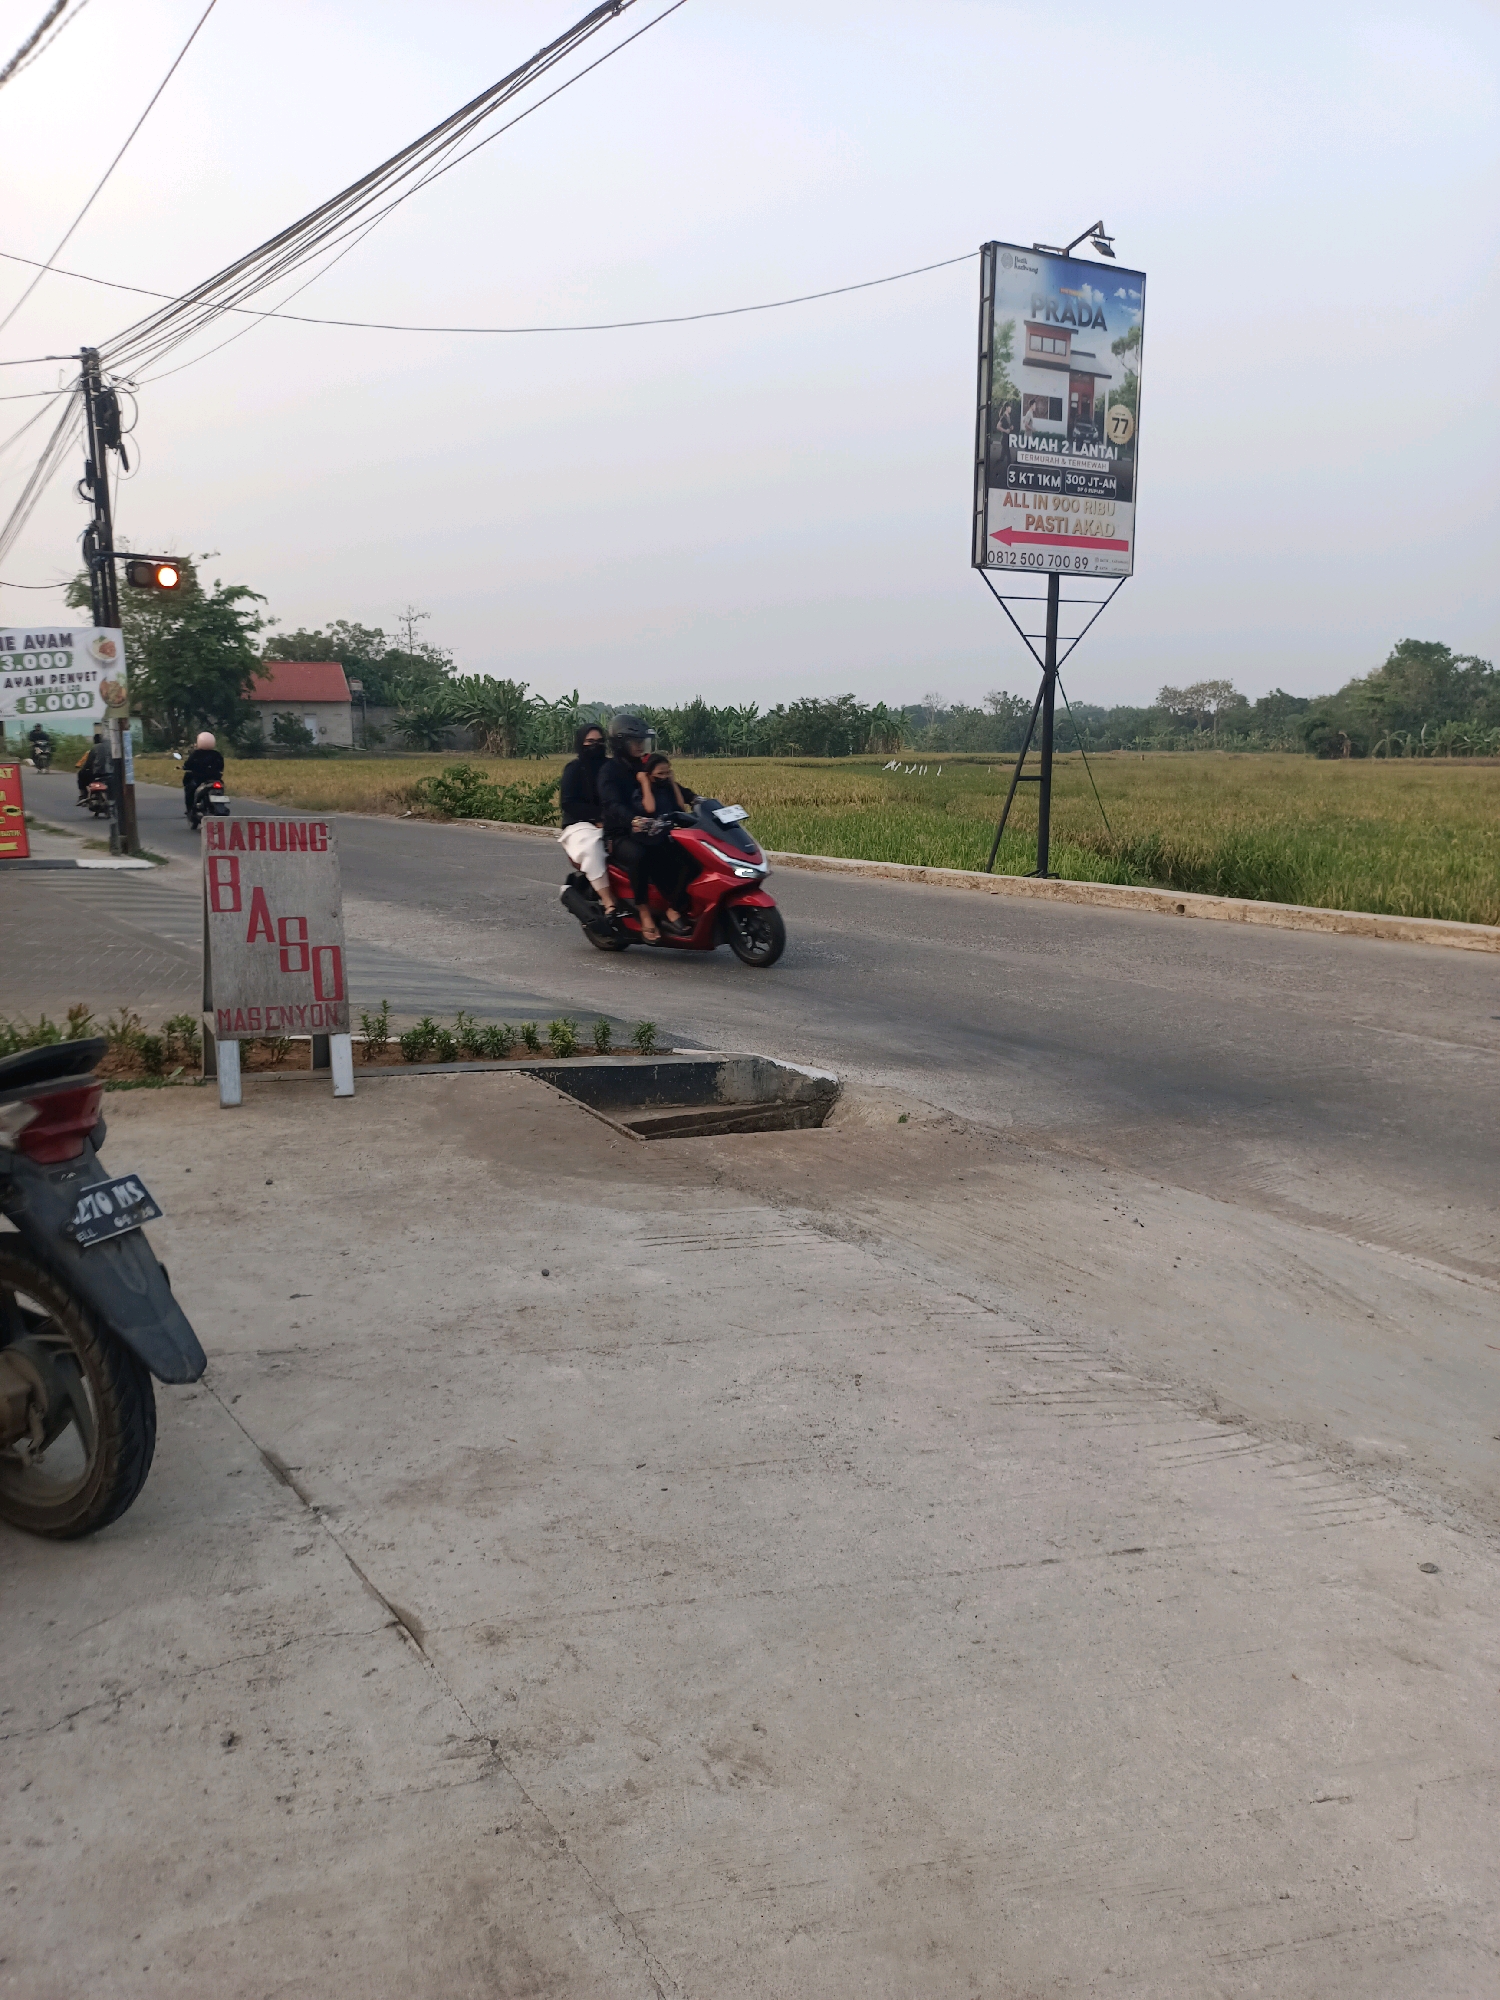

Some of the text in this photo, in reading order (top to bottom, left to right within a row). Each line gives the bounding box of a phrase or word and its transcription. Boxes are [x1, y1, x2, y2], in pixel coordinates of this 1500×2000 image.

[1030, 294, 1108, 332] PRADA
[1112, 417, 1129, 435] 77
[1008, 434, 1118, 460] RUMAH 2 LANTAI
[1020, 453, 1060, 465] TERMURAH
[1068, 459, 1107, 470] TERMEWAH
[1008, 471, 1060, 488] 3 KT 1KM
[1065, 474, 1116, 489] 300 JT-AN
[1002, 491, 1116, 516] ALL IN 900 RIBU
[1025, 513, 1116, 538] PASTI AKAD
[987, 550, 1017, 565] 0812
[1020, 553, 1044, 567] 500
[1048, 554, 1071, 568] 700
[1074, 556, 1089, 570] 89
[23, 633, 74, 650] AYAM
[3, 671, 98, 689] AYAM PENYET
[25, 692, 90, 712] 5.000
[111, 1181, 145, 1209] MS
